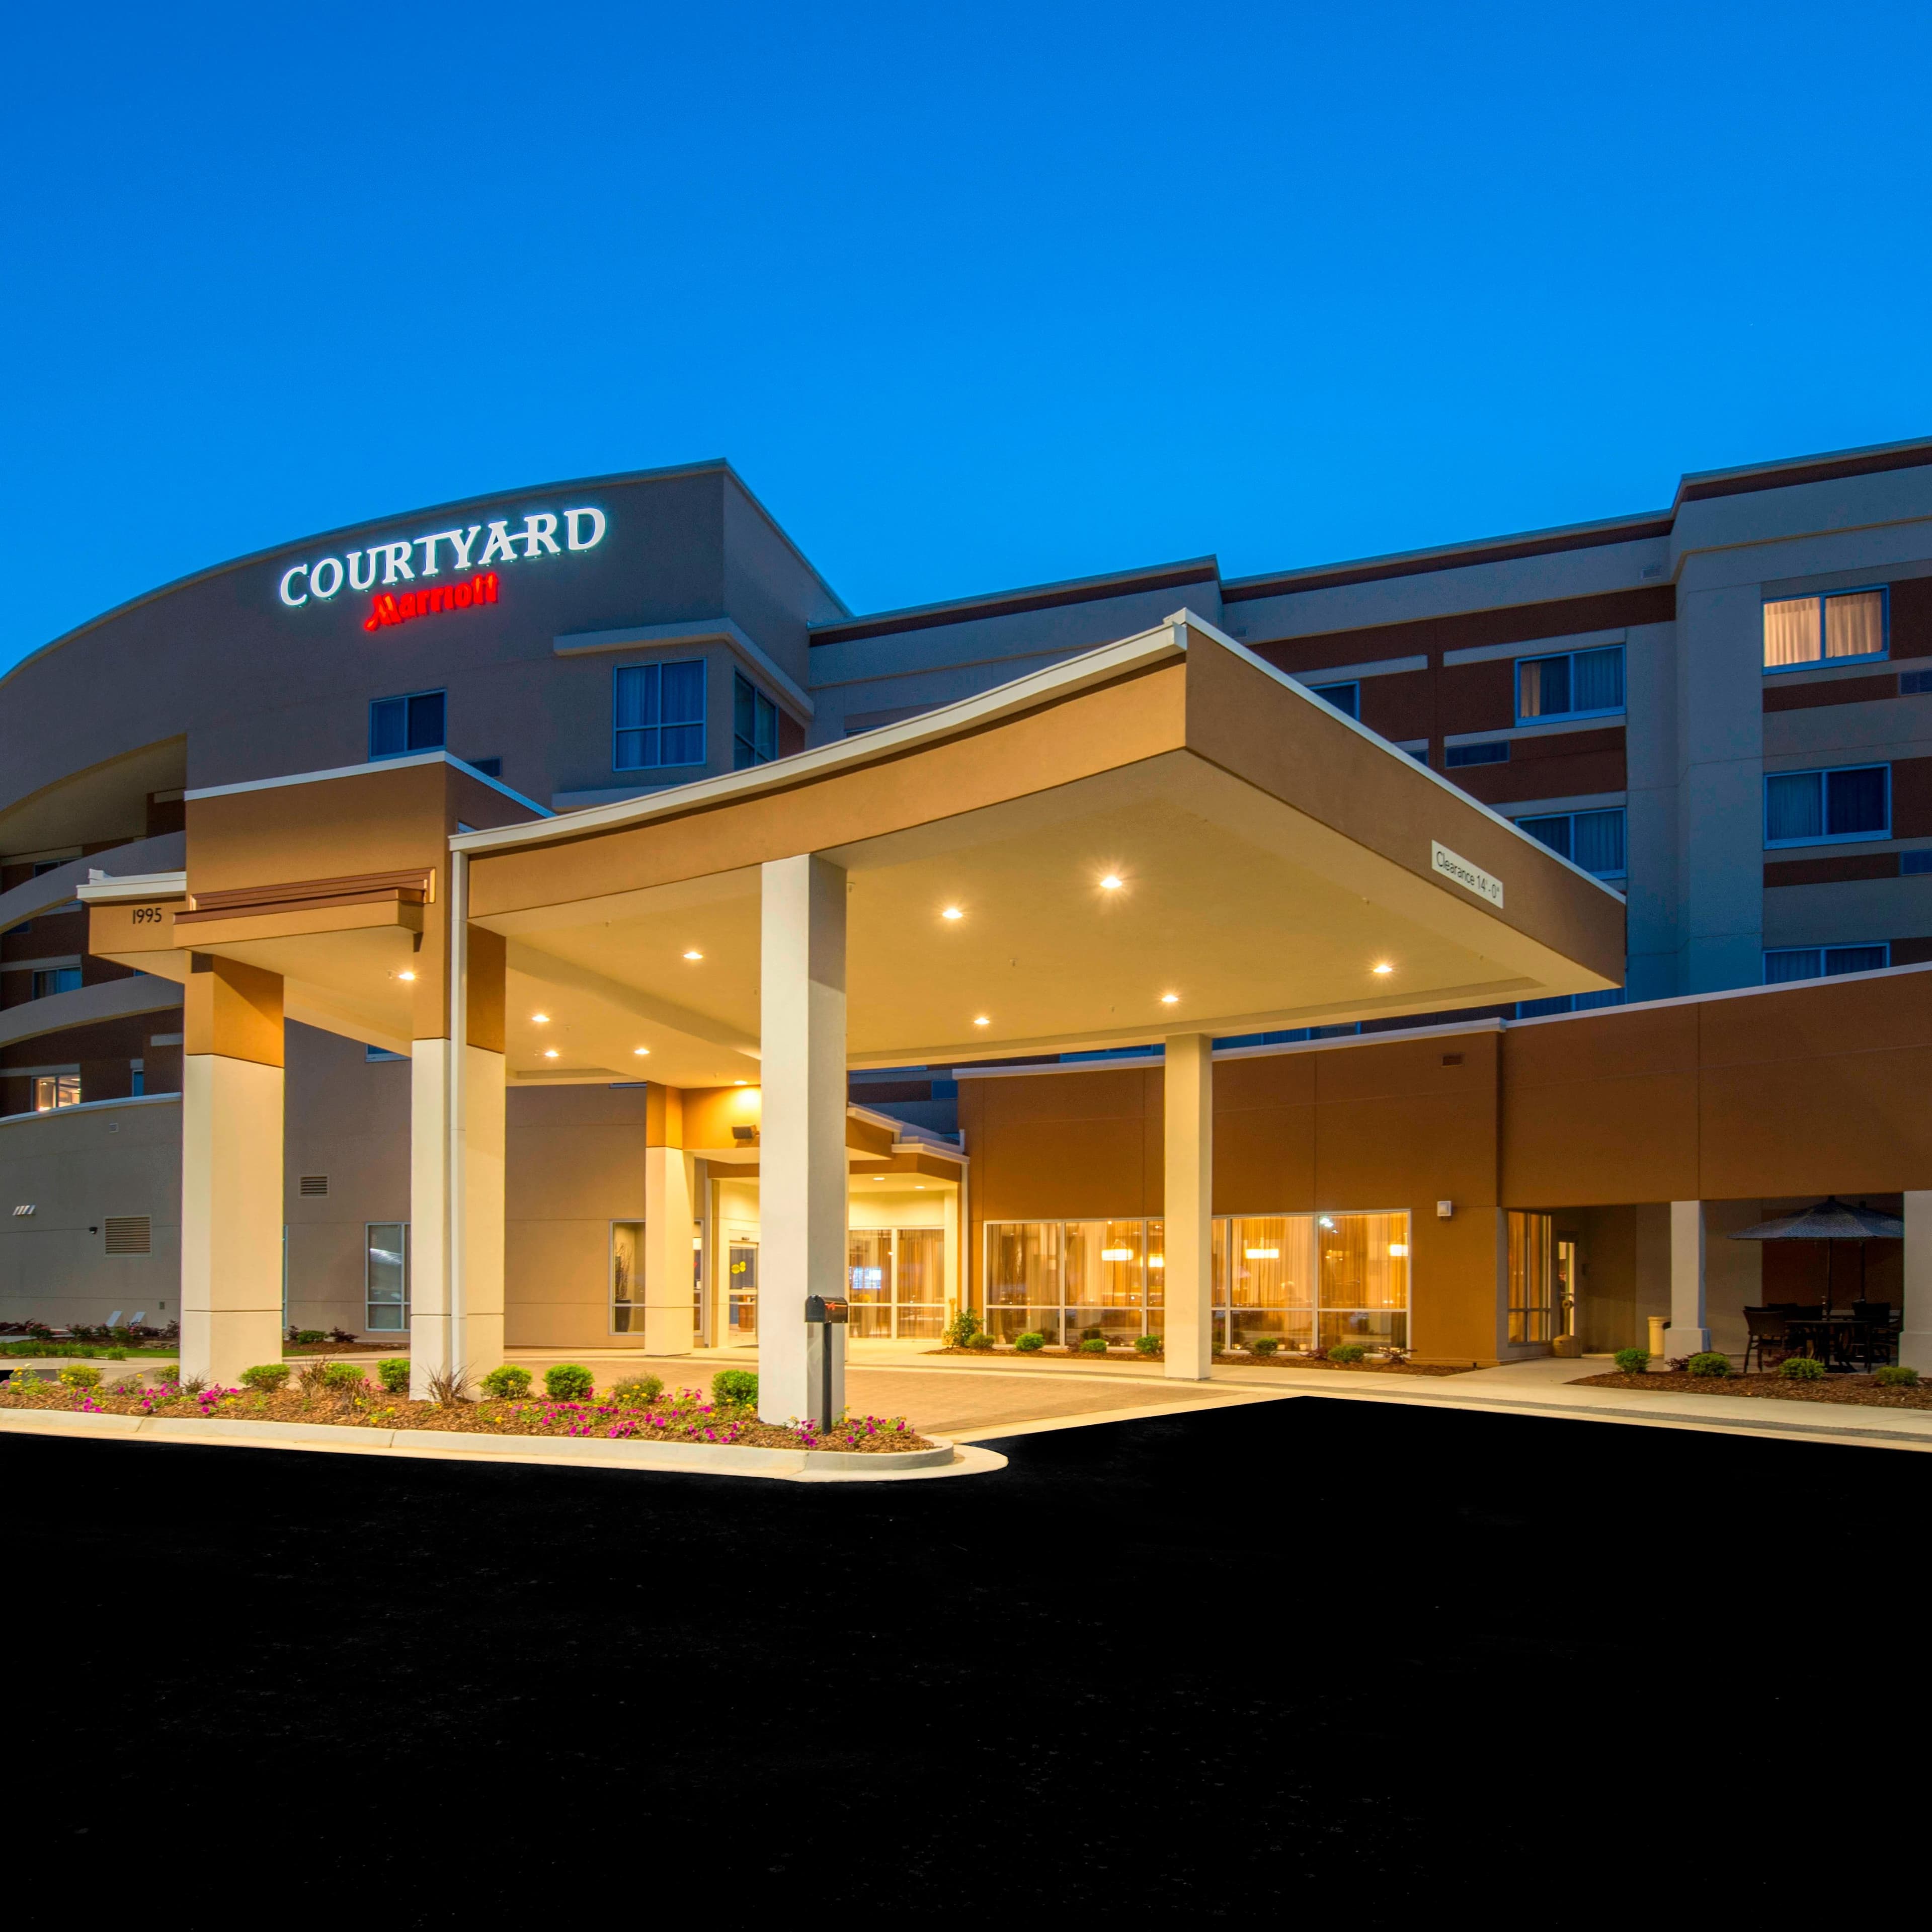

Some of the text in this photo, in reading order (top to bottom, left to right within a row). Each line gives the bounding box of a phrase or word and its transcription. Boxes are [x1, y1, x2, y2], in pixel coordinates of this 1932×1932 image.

[279, 507, 606, 606] COURTYARD
[364, 572, 499, 631] Marriott
[1436, 851, 1475, 886] Clearance
[132, 907, 163, 925] 1995
